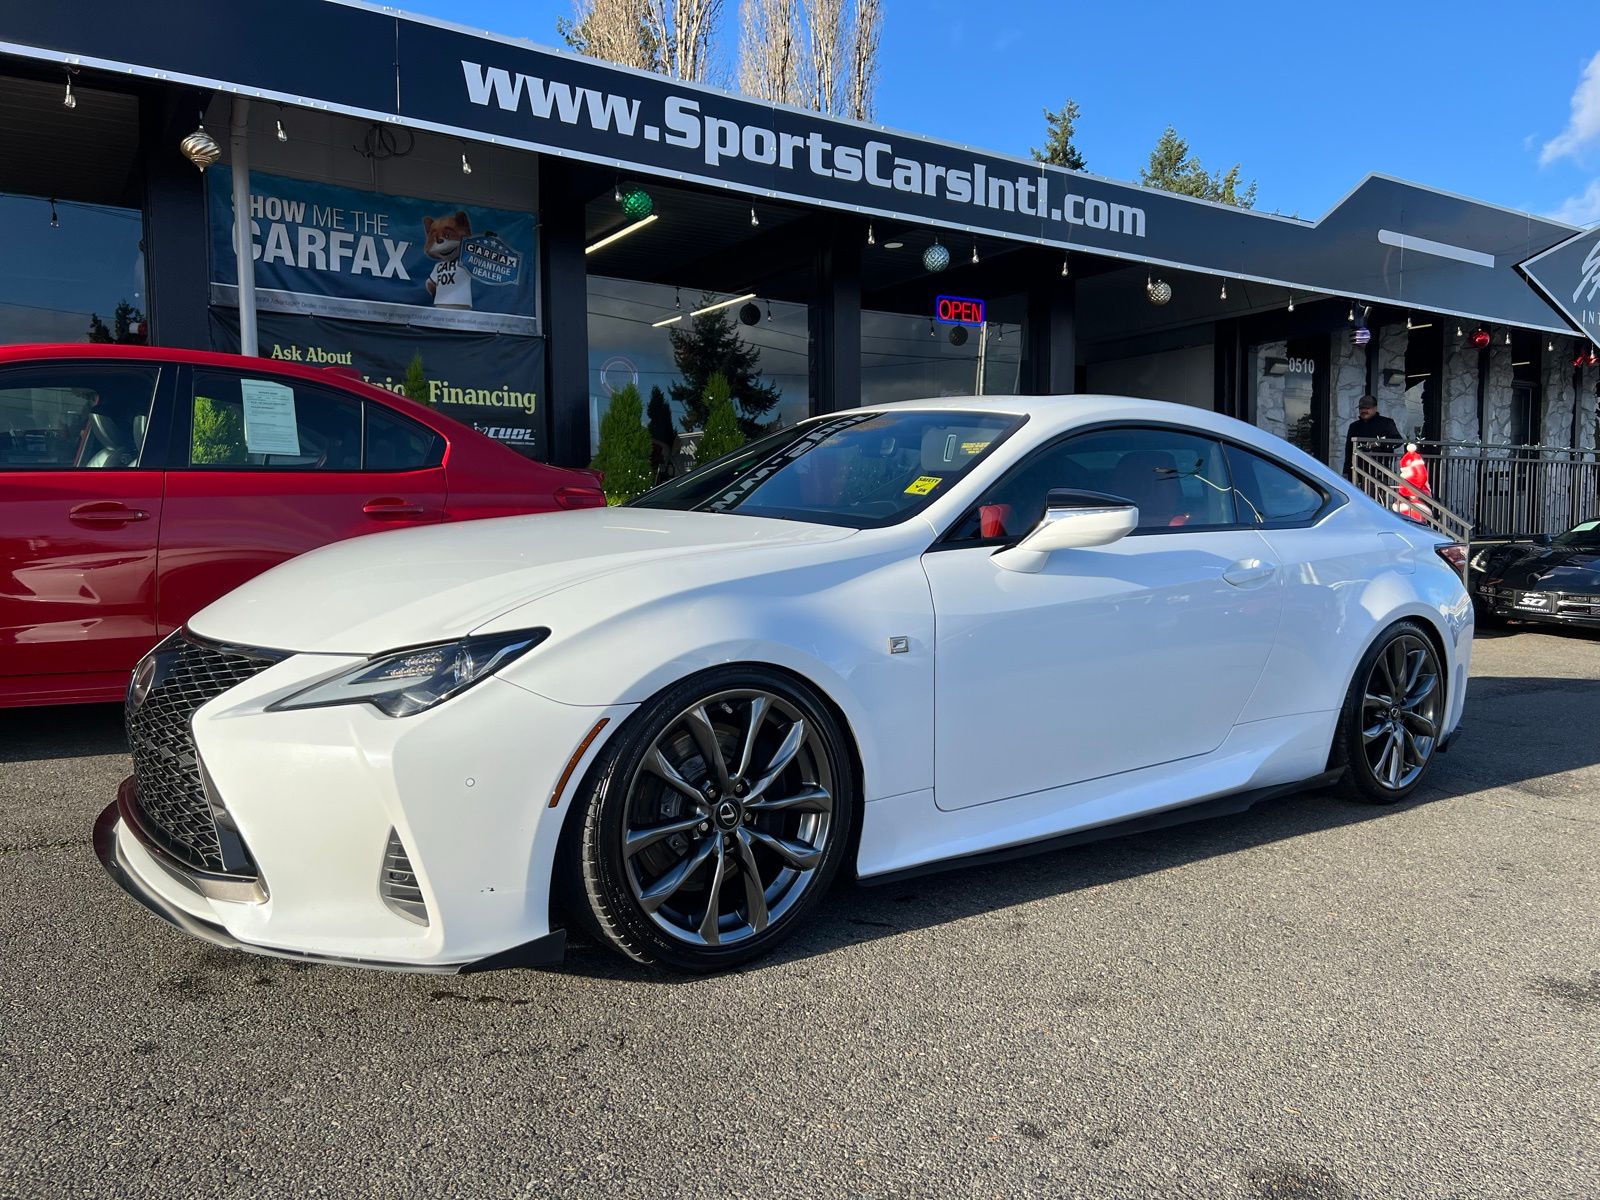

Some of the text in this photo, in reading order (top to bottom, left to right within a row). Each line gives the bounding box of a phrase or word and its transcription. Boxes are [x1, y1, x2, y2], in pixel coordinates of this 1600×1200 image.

[231, 194, 389, 237] HOW ME THE
[467, 244, 516, 267] CARFAX
[437, 260, 457, 273] CAR
[468, 256, 511, 276] ADVANTAGE
[473, 267, 502, 282] DEALER
[437, 273, 456, 285] FOX
[939, 299, 982, 322] OPEN
[271, 345, 352, 365] Ask About
[428, 380, 536, 414] Financing
